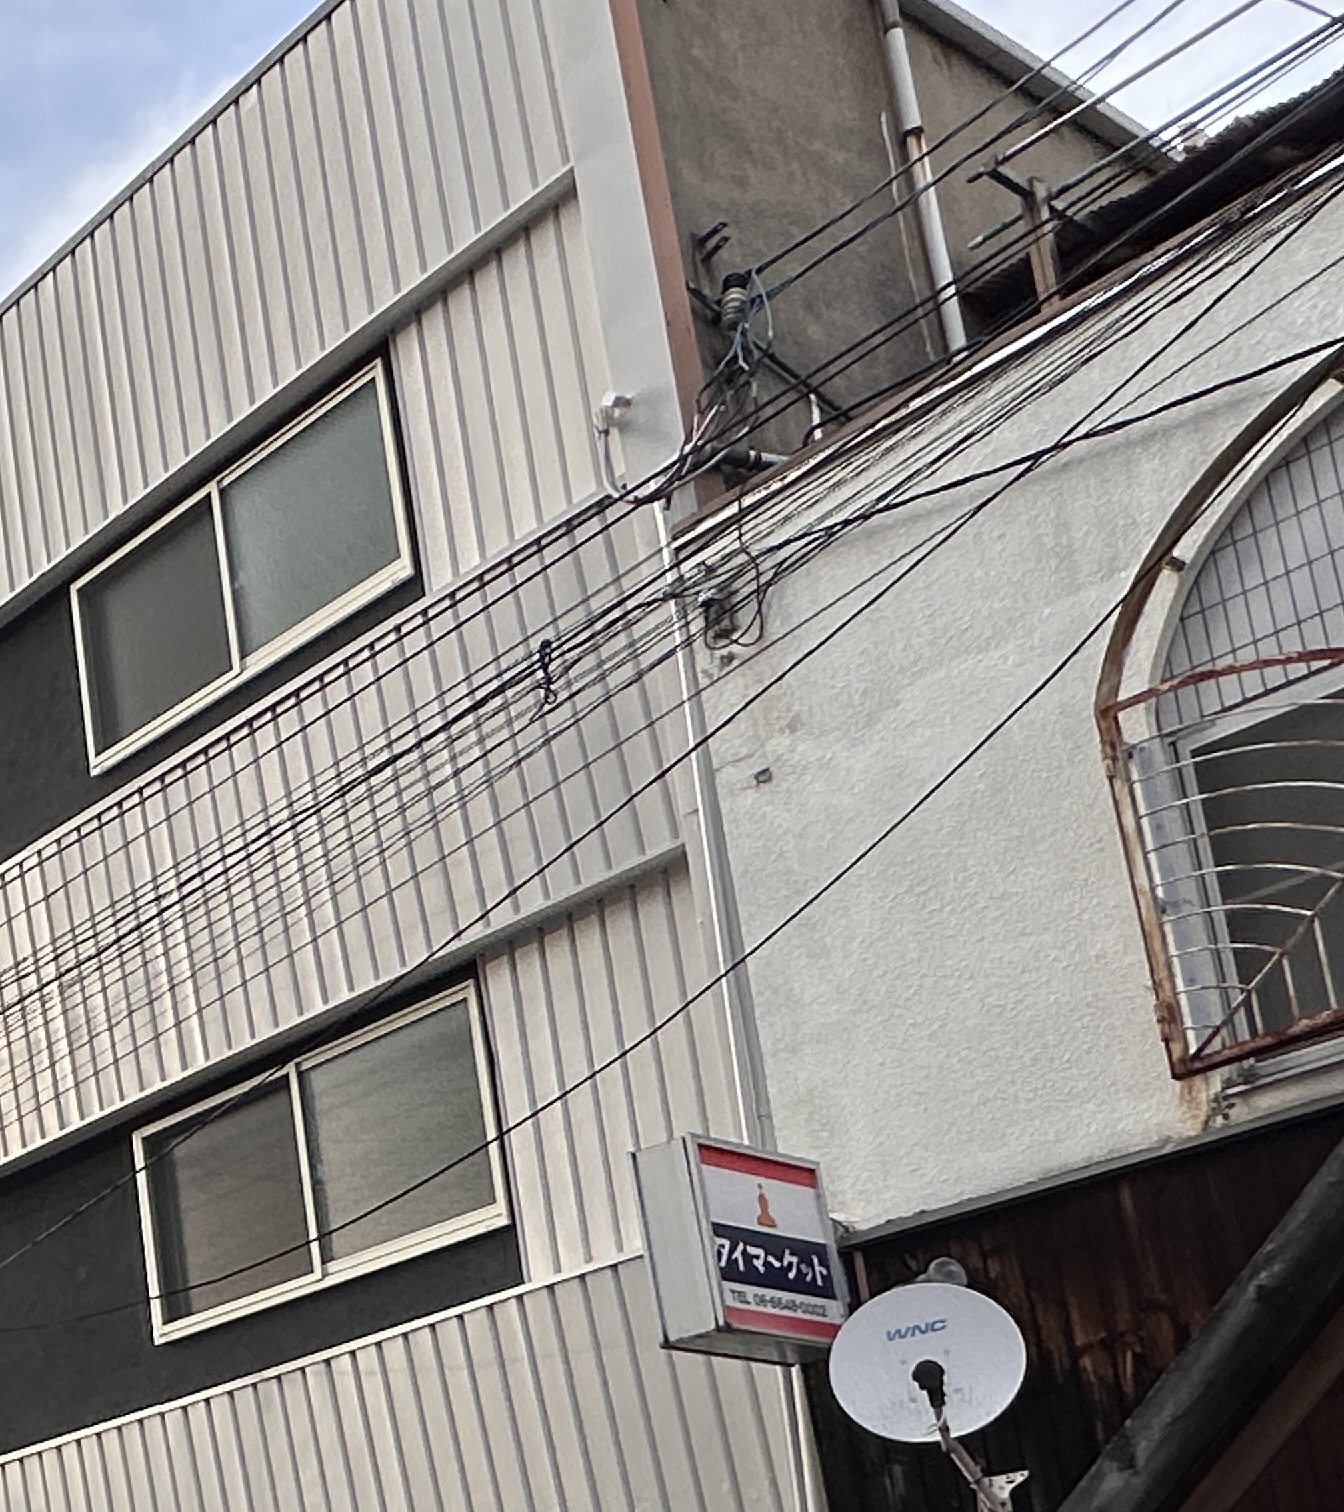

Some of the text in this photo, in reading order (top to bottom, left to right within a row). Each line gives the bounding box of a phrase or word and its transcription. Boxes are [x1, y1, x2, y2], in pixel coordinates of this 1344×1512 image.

[713, 1236, 828, 1287] タイマーケット
[886, 1318, 948, 1341] WNC
